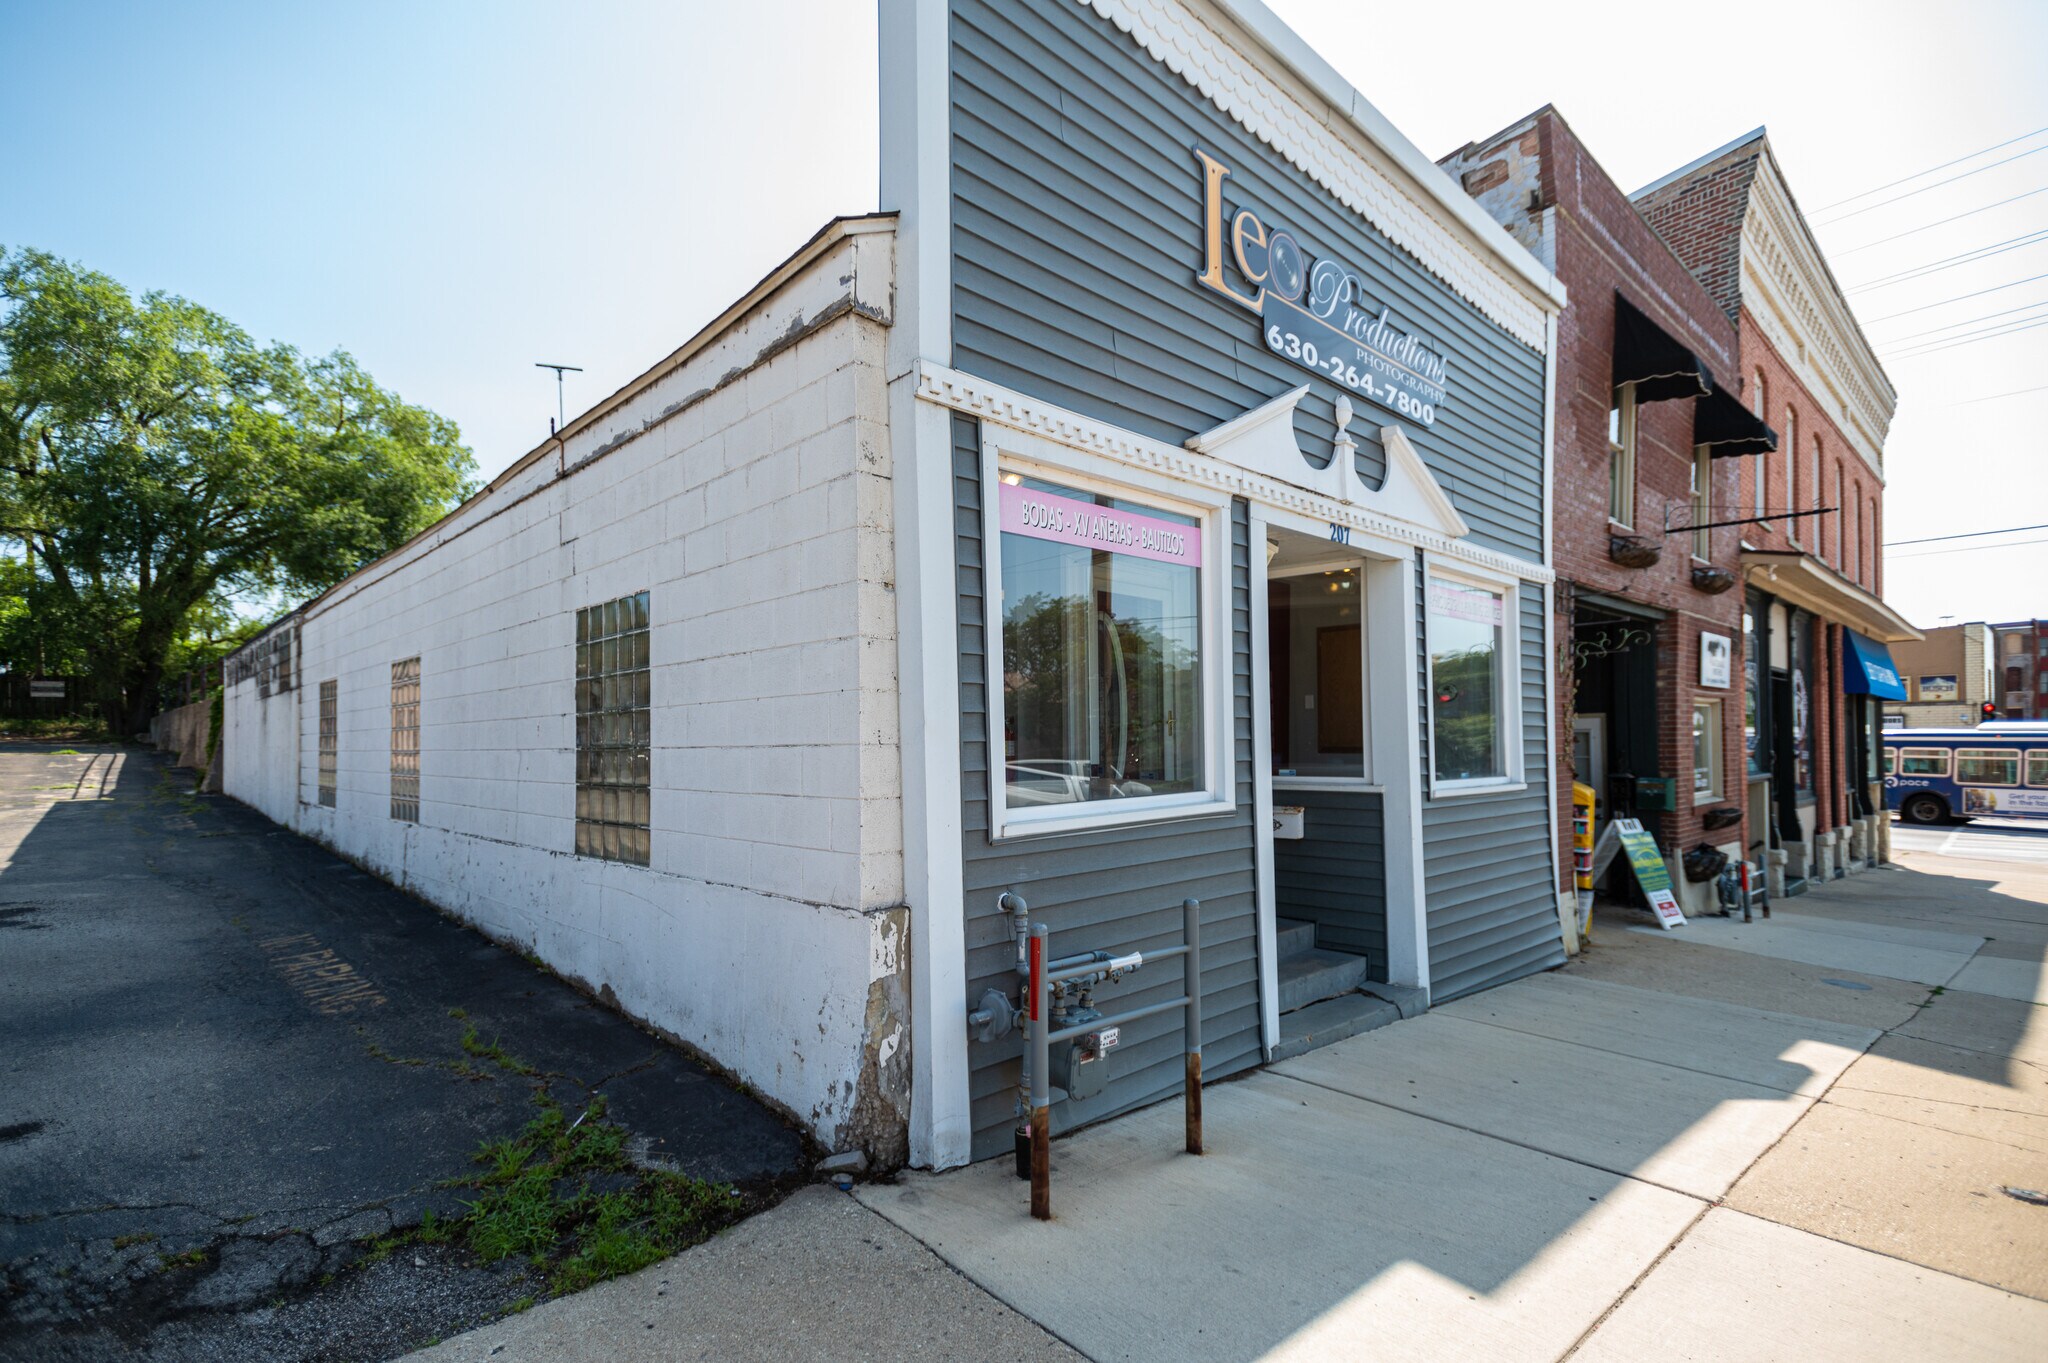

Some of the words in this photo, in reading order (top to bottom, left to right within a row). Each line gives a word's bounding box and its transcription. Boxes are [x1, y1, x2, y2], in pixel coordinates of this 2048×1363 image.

[1308, 259, 1447, 385] Productions
[1267, 324, 1435, 425] 630-264-7800
[1356, 347, 1446, 405] PHOTOGRAPHY
[1022, 500, 1063, 532] BODAS
[1073, 511, 1090, 537] XV
[1141, 527, 1185, 556] BAUTIZOS
[1330, 523, 1350, 545] 207
[1900, 779, 1930, 787] pace
